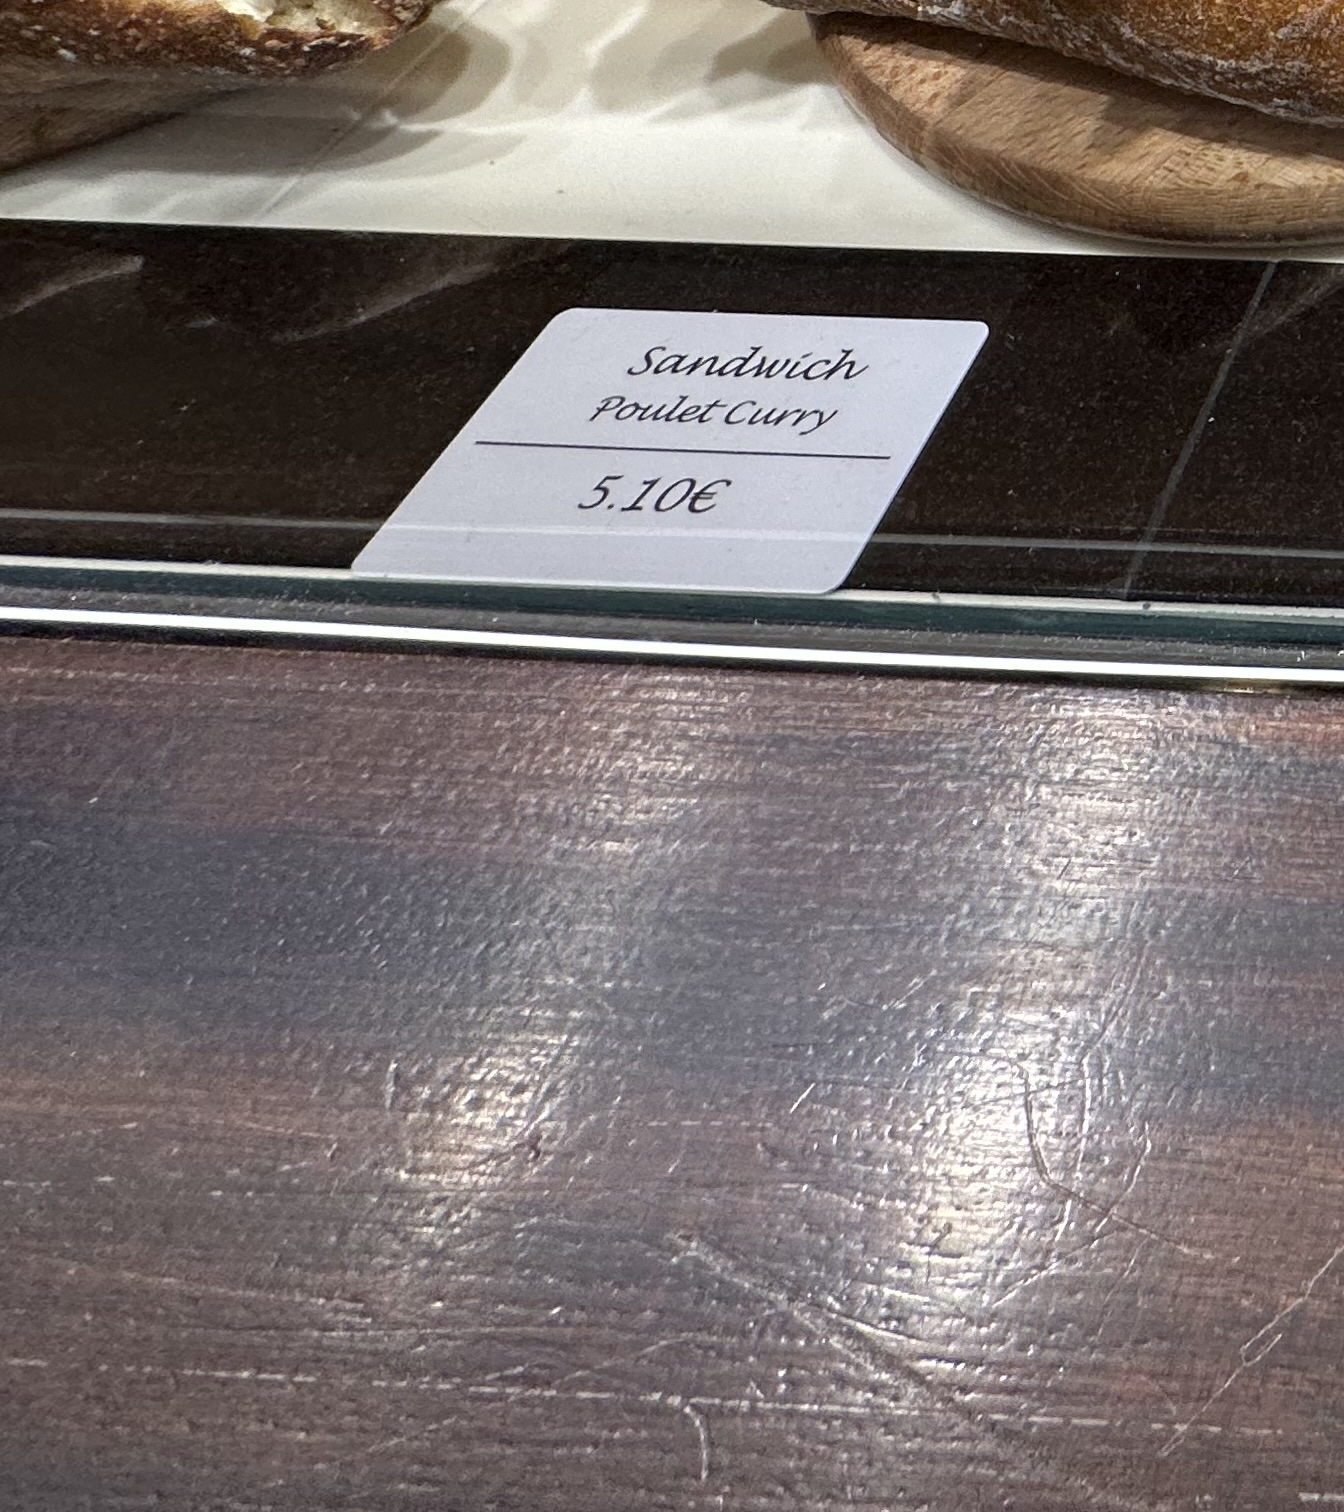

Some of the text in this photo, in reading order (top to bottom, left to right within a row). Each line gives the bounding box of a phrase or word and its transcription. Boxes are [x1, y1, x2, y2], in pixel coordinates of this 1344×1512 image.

[627, 345, 869, 381] Sandwich
[589, 395, 839, 436] Poulet Curry
[577, 475, 732, 514] 5.10€
